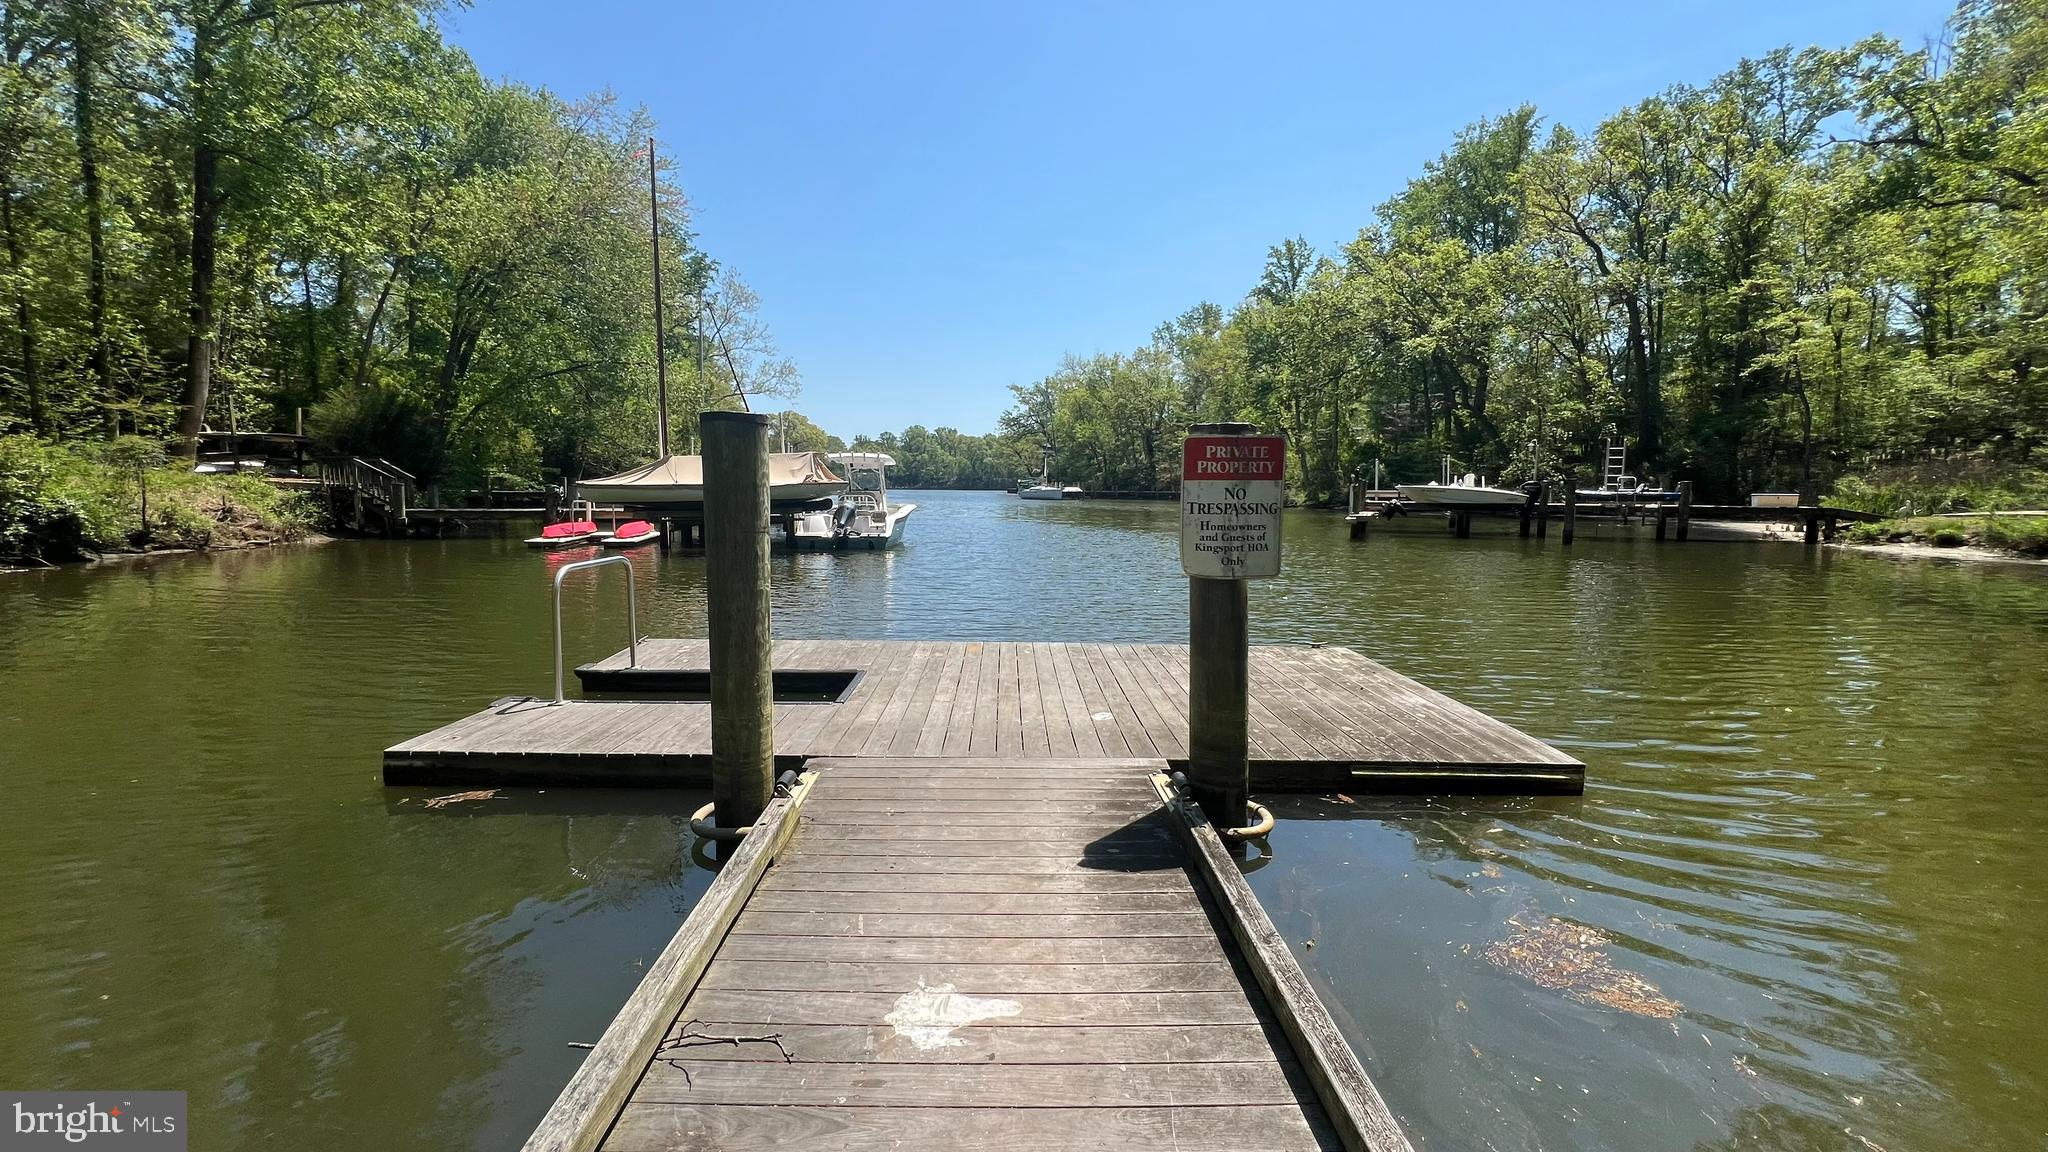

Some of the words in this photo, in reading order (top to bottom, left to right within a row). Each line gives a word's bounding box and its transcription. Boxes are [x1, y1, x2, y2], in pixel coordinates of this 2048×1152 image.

[1206, 446, 1269, 458] PRIVATE
[1197, 461, 1275, 473] PROPERTY
[1224, 488, 1247, 500] NO
[1187, 502, 1278, 515] TRESPASSING
[1200, 521, 1267, 531] Homeowners
[1199, 533, 1218, 542] and
[1221, 533, 1255, 542] Guests
[1257, 532, 1267, 542] of
[1195, 543, 1244, 554] Kingsport
[1248, 543, 1269, 552] HOA
[1221, 556, 1246, 566] Only
